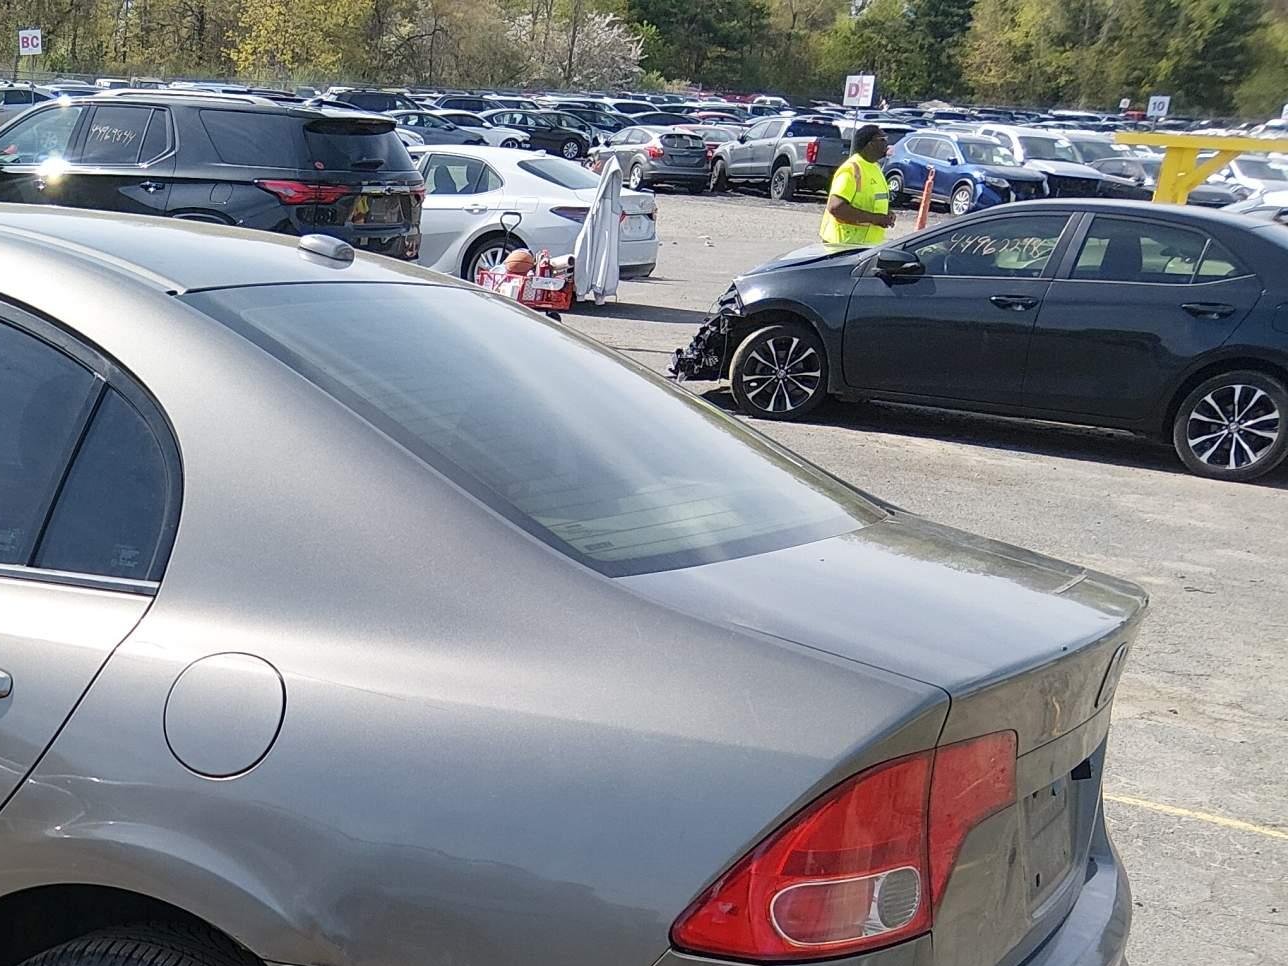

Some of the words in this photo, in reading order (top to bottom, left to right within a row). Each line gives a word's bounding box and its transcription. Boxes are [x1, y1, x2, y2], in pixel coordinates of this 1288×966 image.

[21, 36, 40, 49] BC
[848, 82, 870, 98] DE
[1152, 101, 1165, 111] 10
